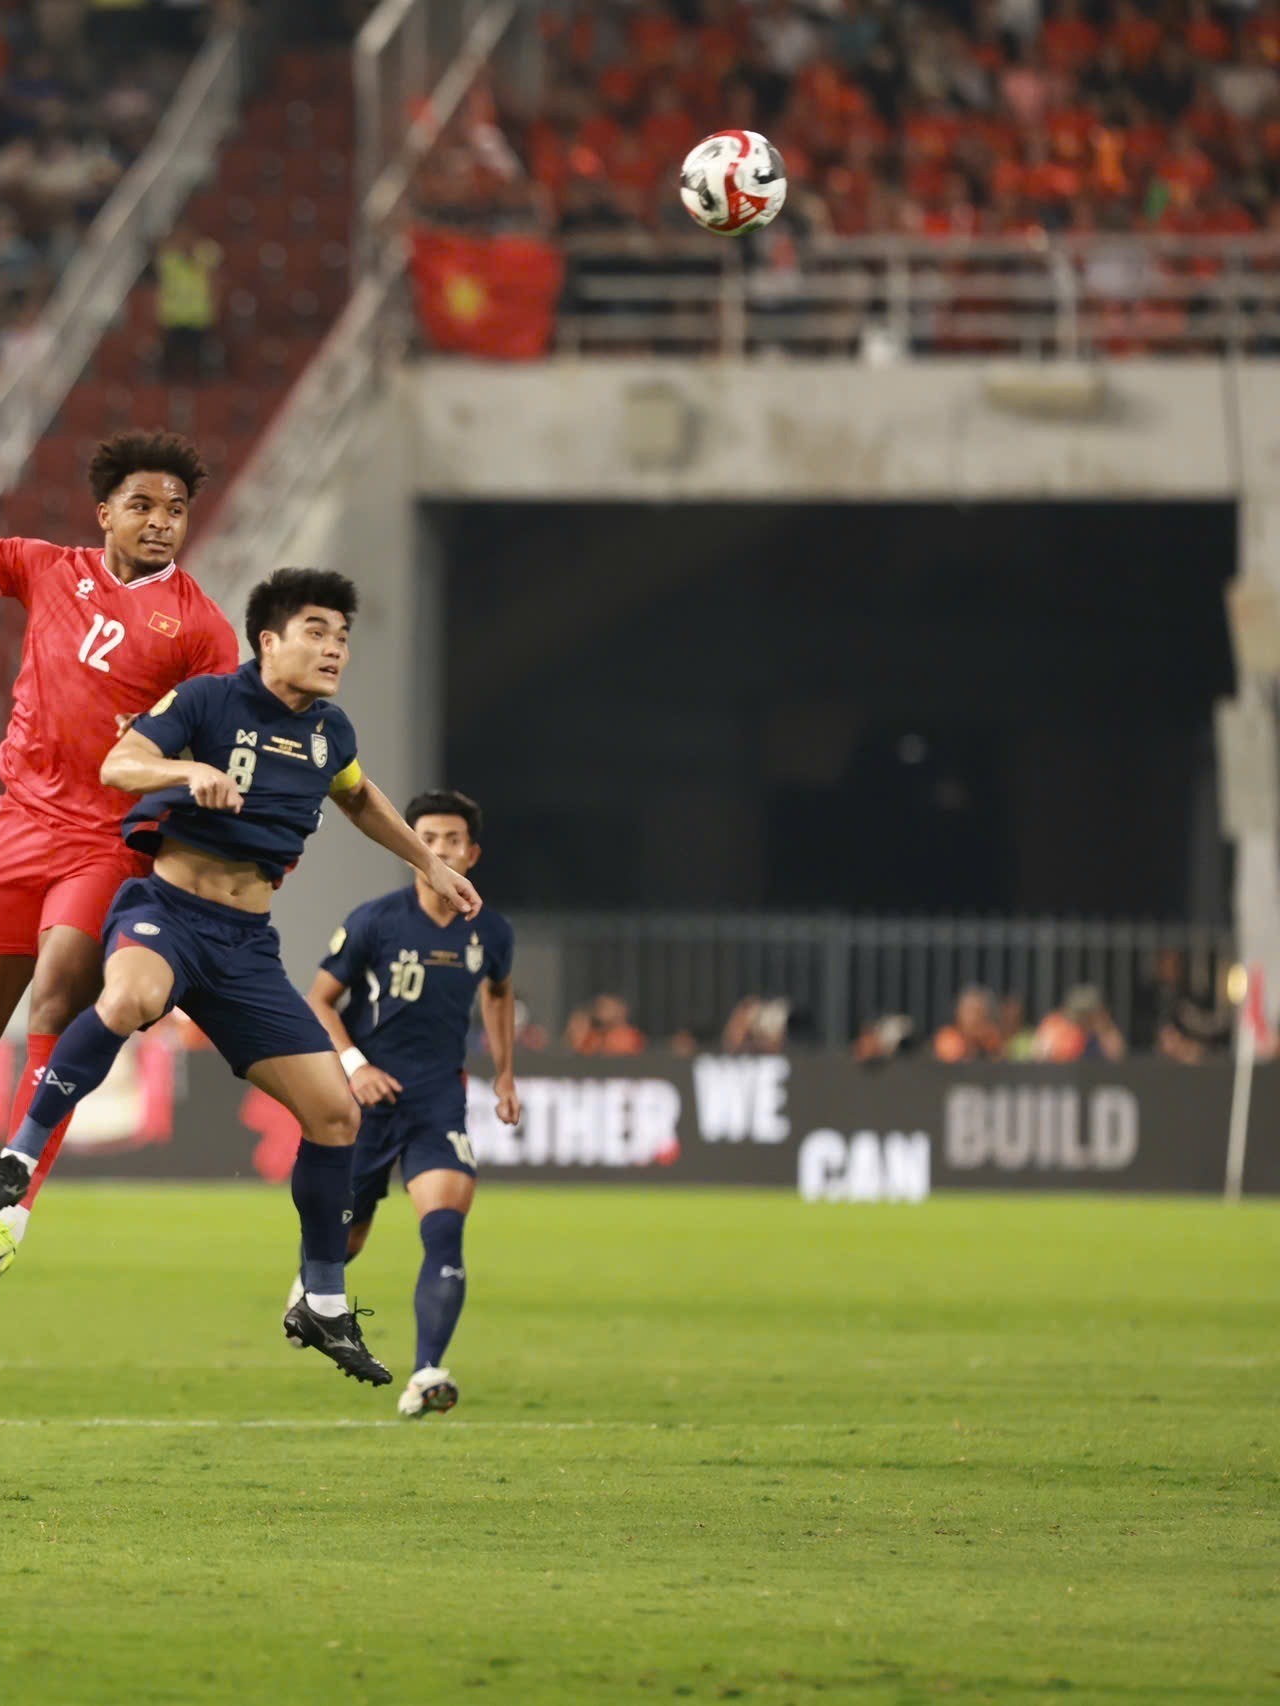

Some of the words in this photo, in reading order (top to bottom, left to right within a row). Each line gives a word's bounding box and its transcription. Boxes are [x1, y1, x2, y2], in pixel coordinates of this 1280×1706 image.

[77, 612, 126, 673] 12
[226, 747, 257, 793] 8
[389, 961, 426, 1002] 10
[693, 1053, 790, 1143] WE
[945, 1085, 1138, 1170] BUILD
[797, 1128, 931, 1203] CAN
